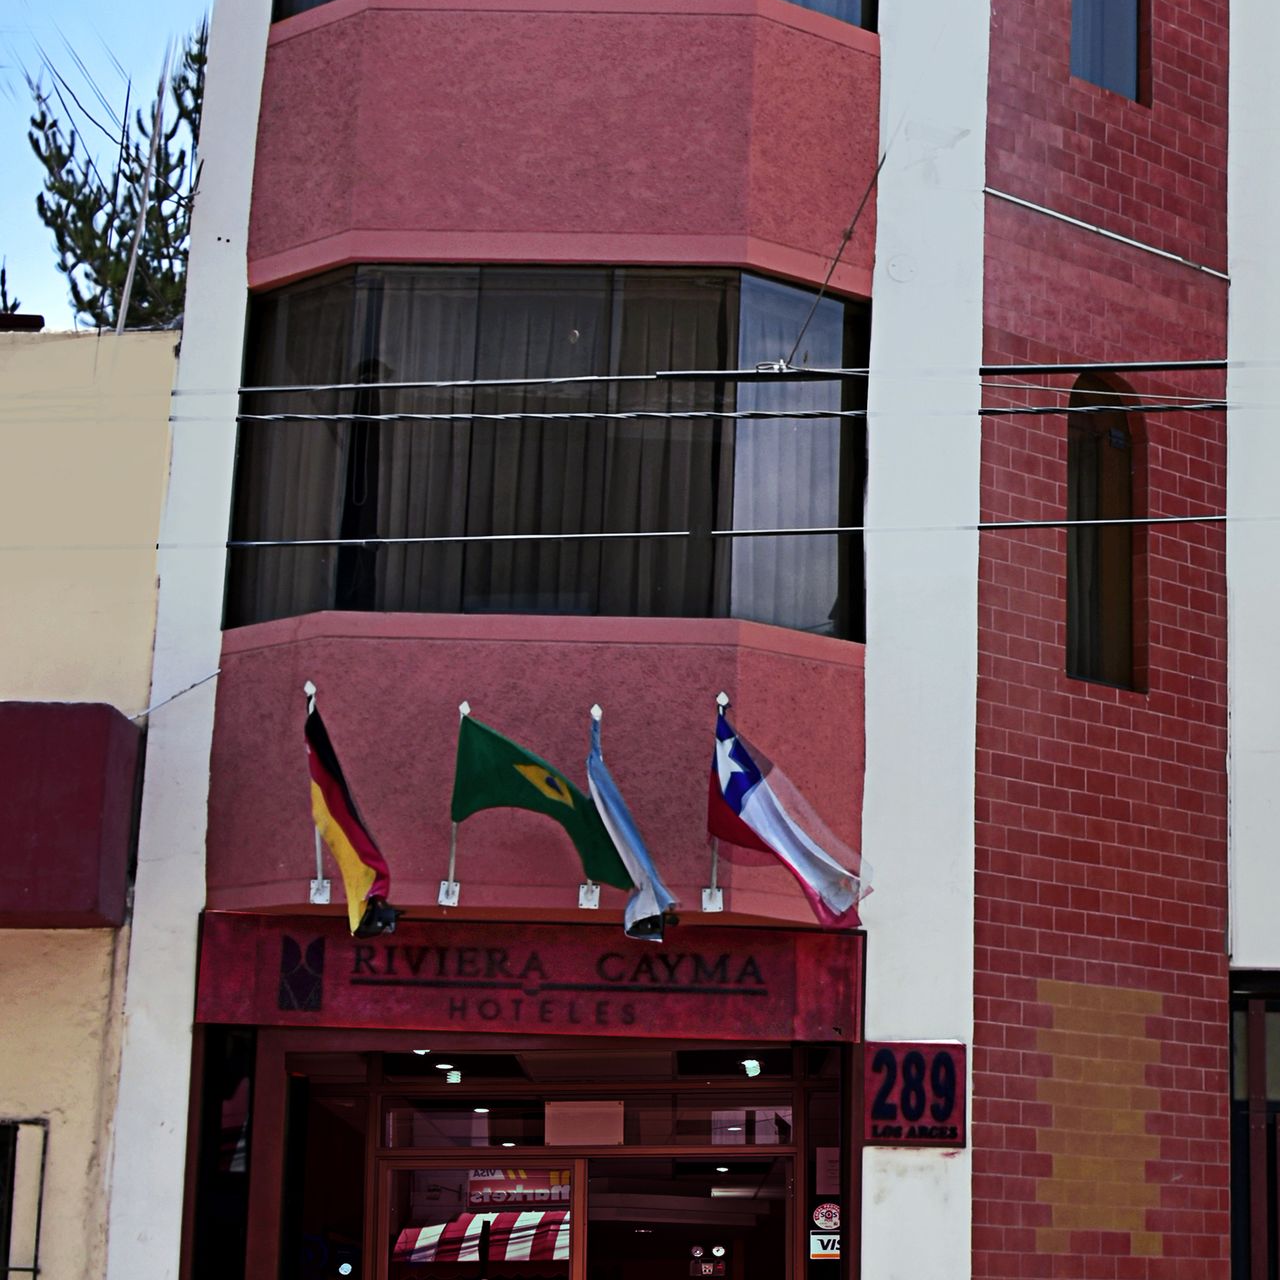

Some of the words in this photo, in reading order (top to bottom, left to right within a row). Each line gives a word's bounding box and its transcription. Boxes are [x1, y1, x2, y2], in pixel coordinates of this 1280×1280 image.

[352, 944, 546, 979] RIVIERA
[596, 951, 766, 985] CAYMA
[447, 996, 637, 1026] HOTELES
[871, 1048, 955, 1122] 289
[872, 1125, 902, 1138] LOS
[820, 1210, 838, 1220] SOS
